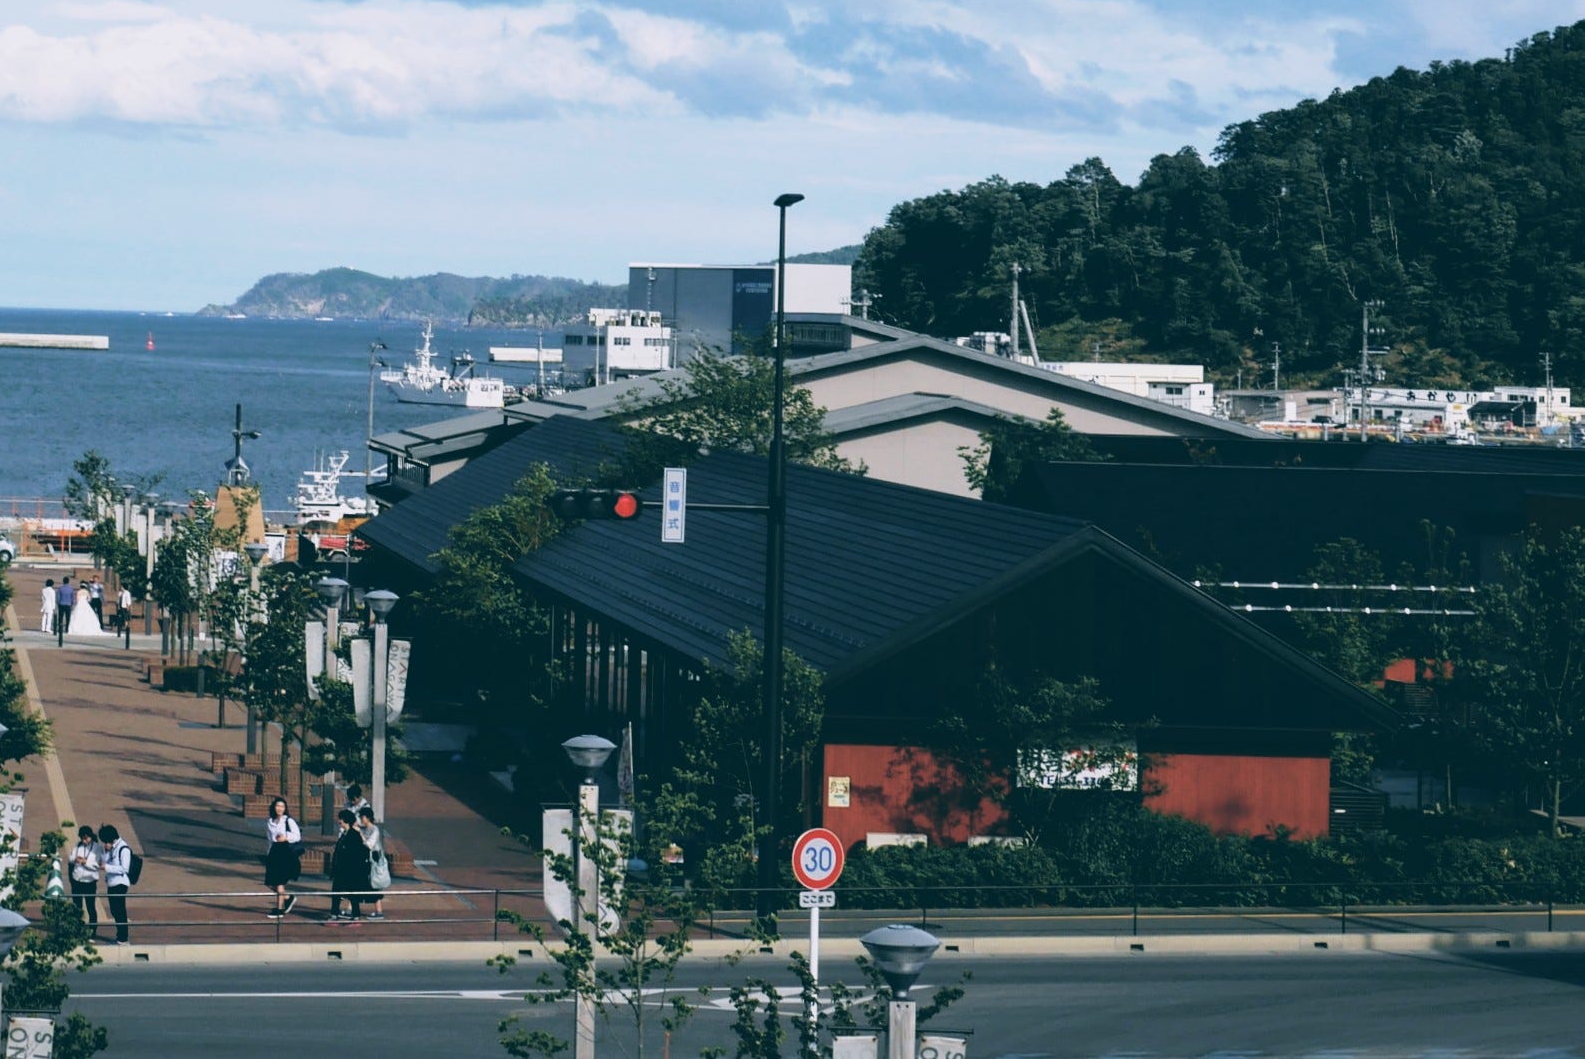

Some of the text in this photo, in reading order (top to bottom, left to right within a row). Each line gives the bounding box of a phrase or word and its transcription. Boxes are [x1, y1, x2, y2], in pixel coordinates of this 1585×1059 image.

[805, 846, 832, 872] 30
[803, 895, 832, 904] ここまで
